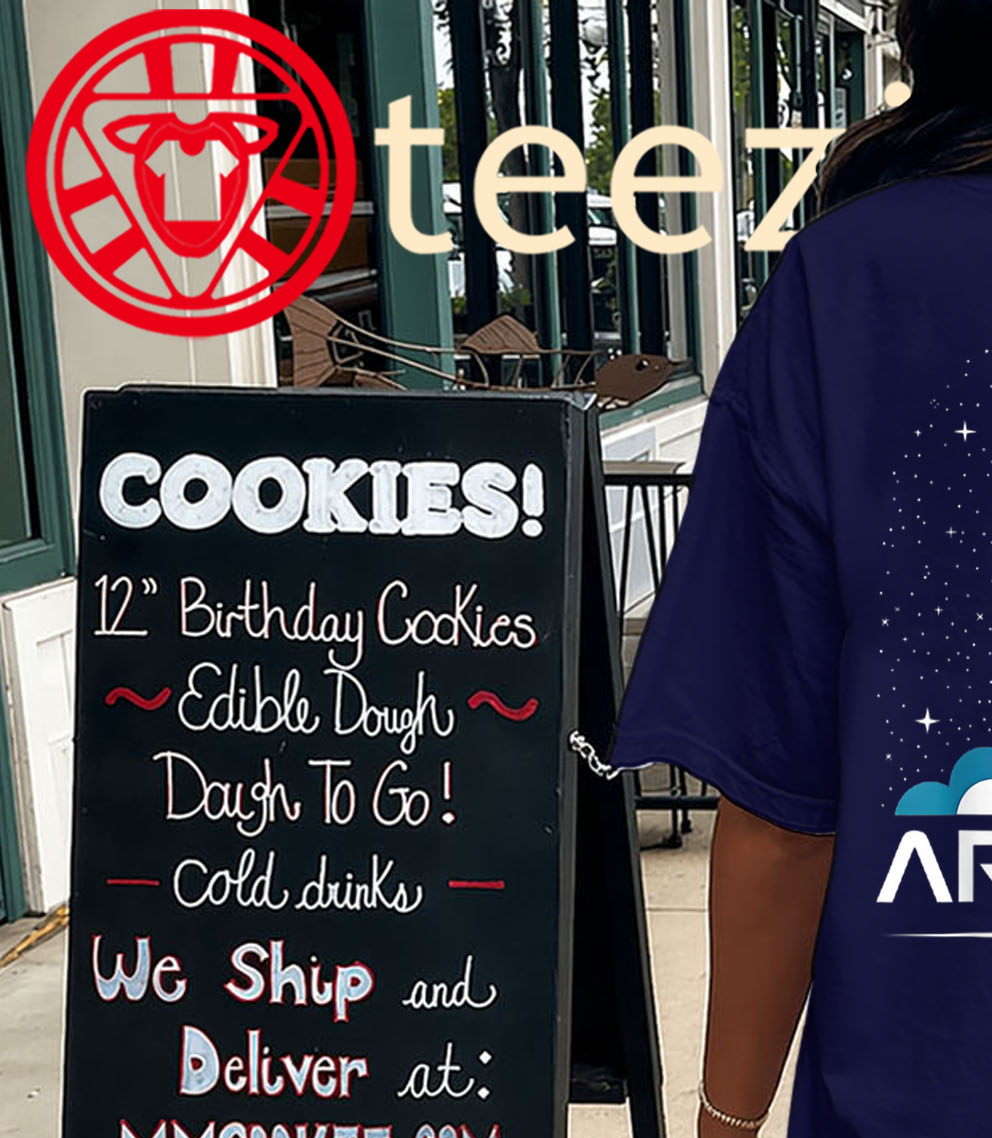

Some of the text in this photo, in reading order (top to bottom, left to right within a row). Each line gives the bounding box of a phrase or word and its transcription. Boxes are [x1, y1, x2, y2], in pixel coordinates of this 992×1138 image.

[100, 453, 544, 538] COOKIES!
[181, 577, 363, 670] Birthday
[178, 662, 454, 754] Edible Dough
[153, 751, 301, 837] Dough
[309, 760, 355, 824] To
[174, 848, 289, 909] Cold
[93, 936, 496, 1022] We Ship and
[180, 1026, 491, 1098] Deliver at:
